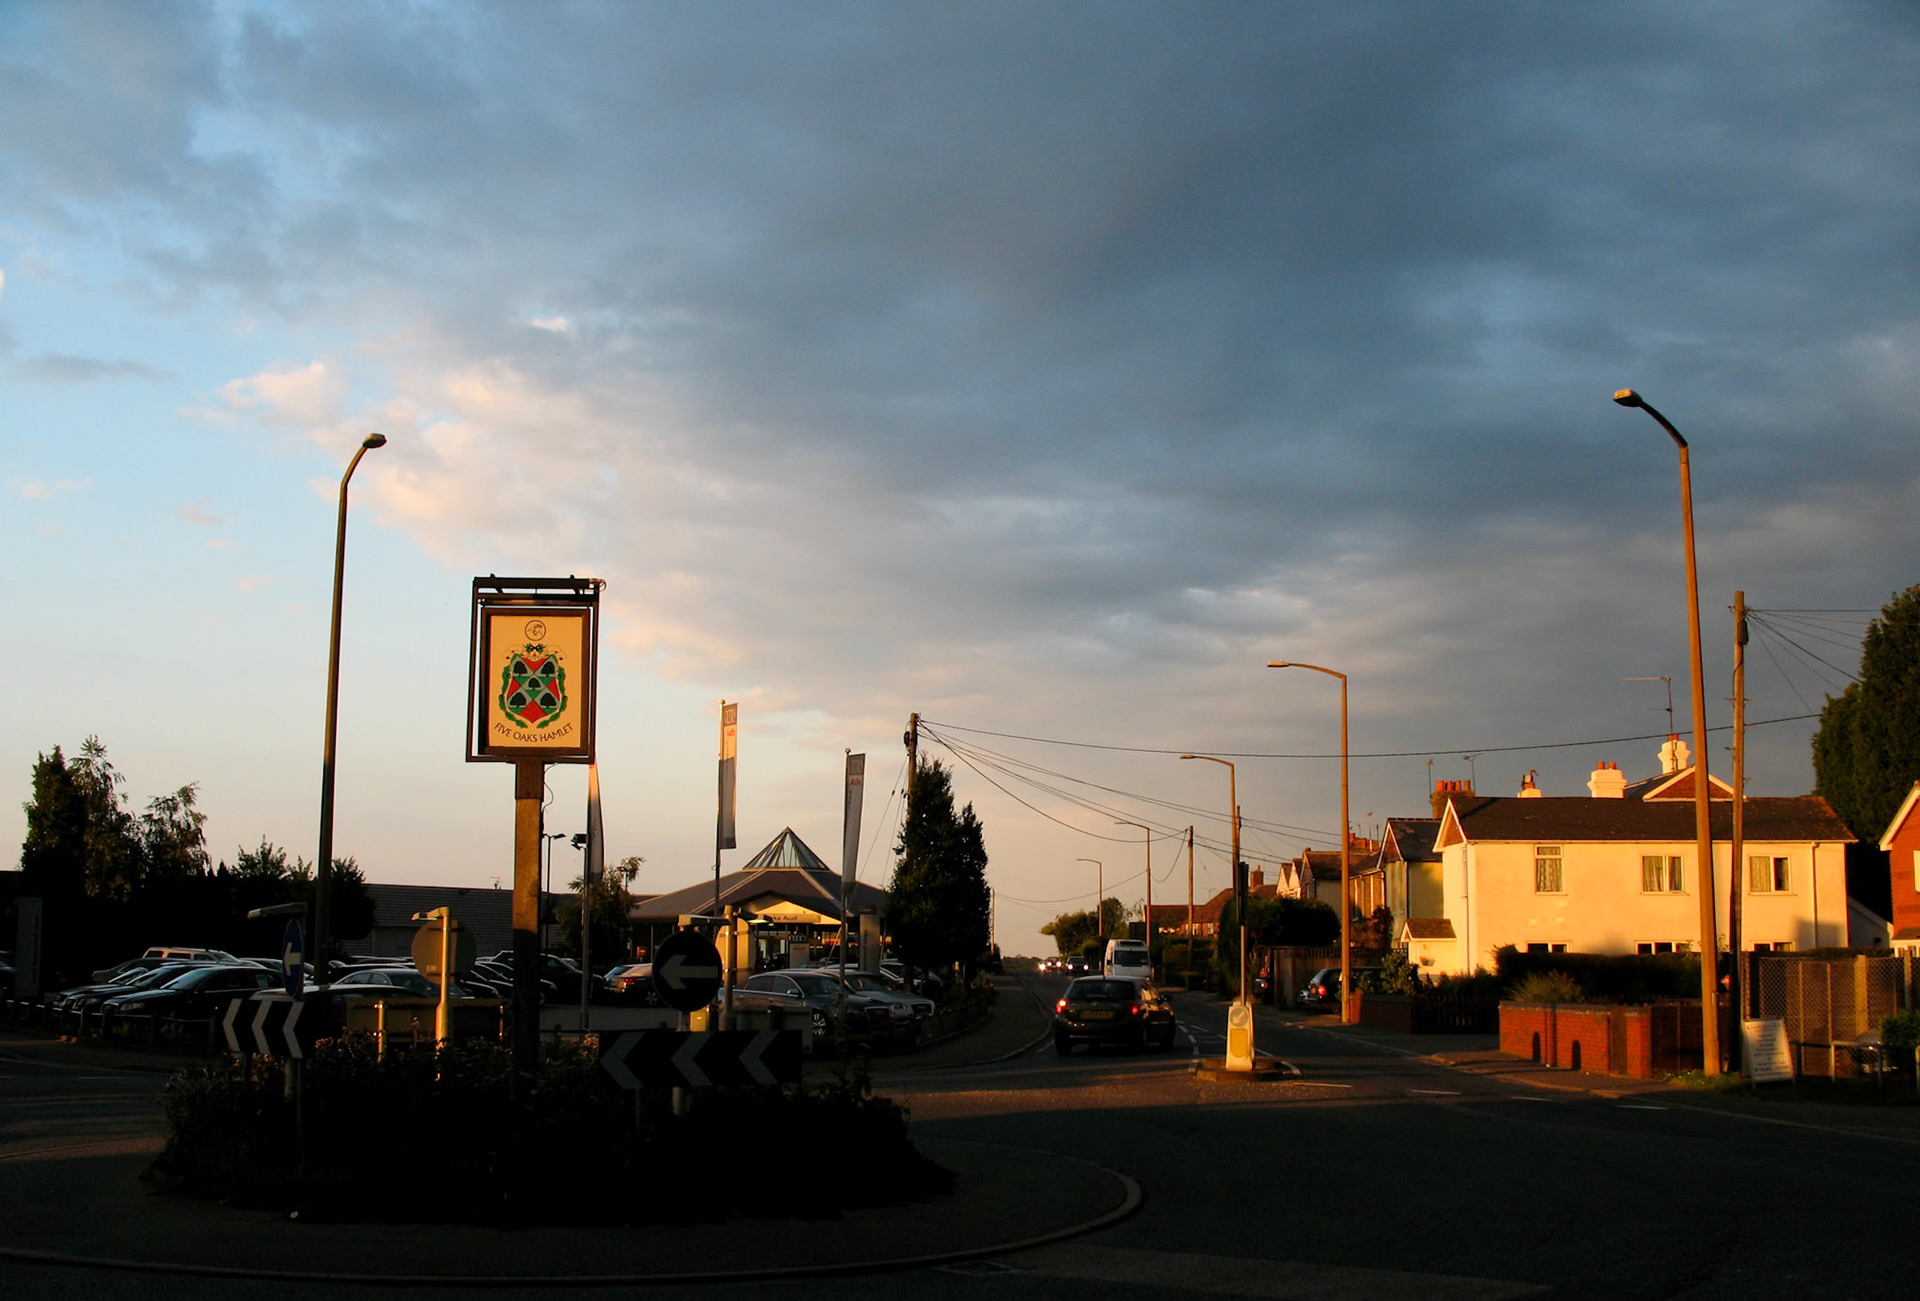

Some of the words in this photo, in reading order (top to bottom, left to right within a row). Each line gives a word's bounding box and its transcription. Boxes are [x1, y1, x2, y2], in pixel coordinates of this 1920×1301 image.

[494, 722, 512, 738] FIVE
[513, 731, 538, 743] OAKS
[540, 722, 573, 742] HAMLET
